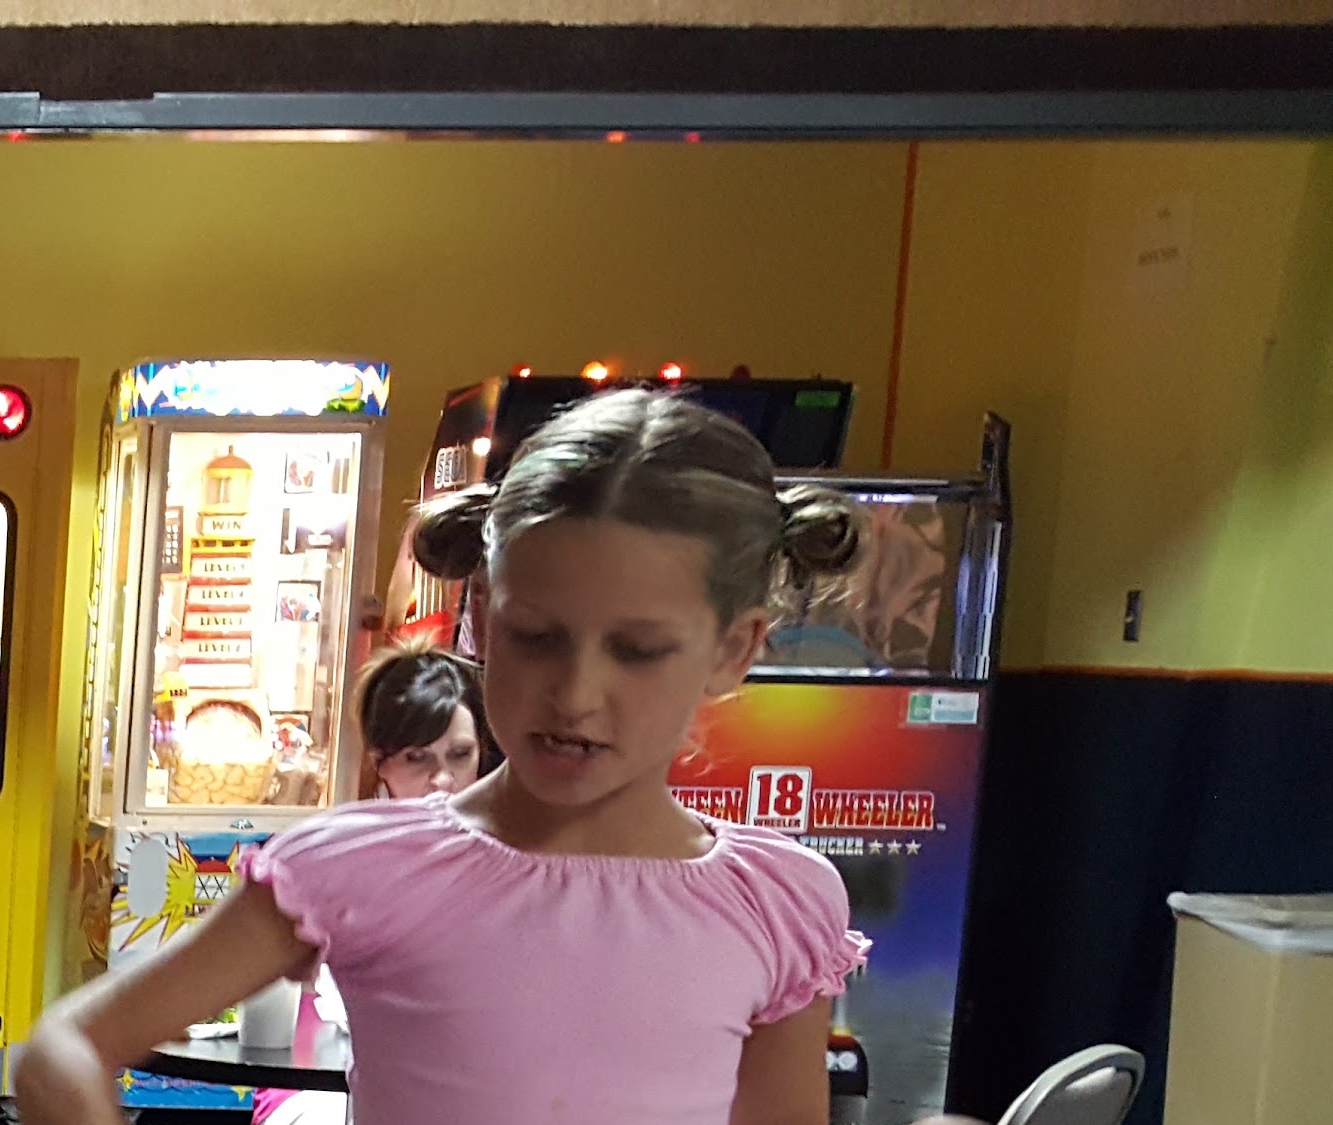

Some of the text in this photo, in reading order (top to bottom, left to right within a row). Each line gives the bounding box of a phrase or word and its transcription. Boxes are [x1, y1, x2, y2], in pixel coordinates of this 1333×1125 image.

[212, 520, 242, 530] WIN
[755, 773, 804, 816] 18
[813, 790, 933, 829] WHEELER
